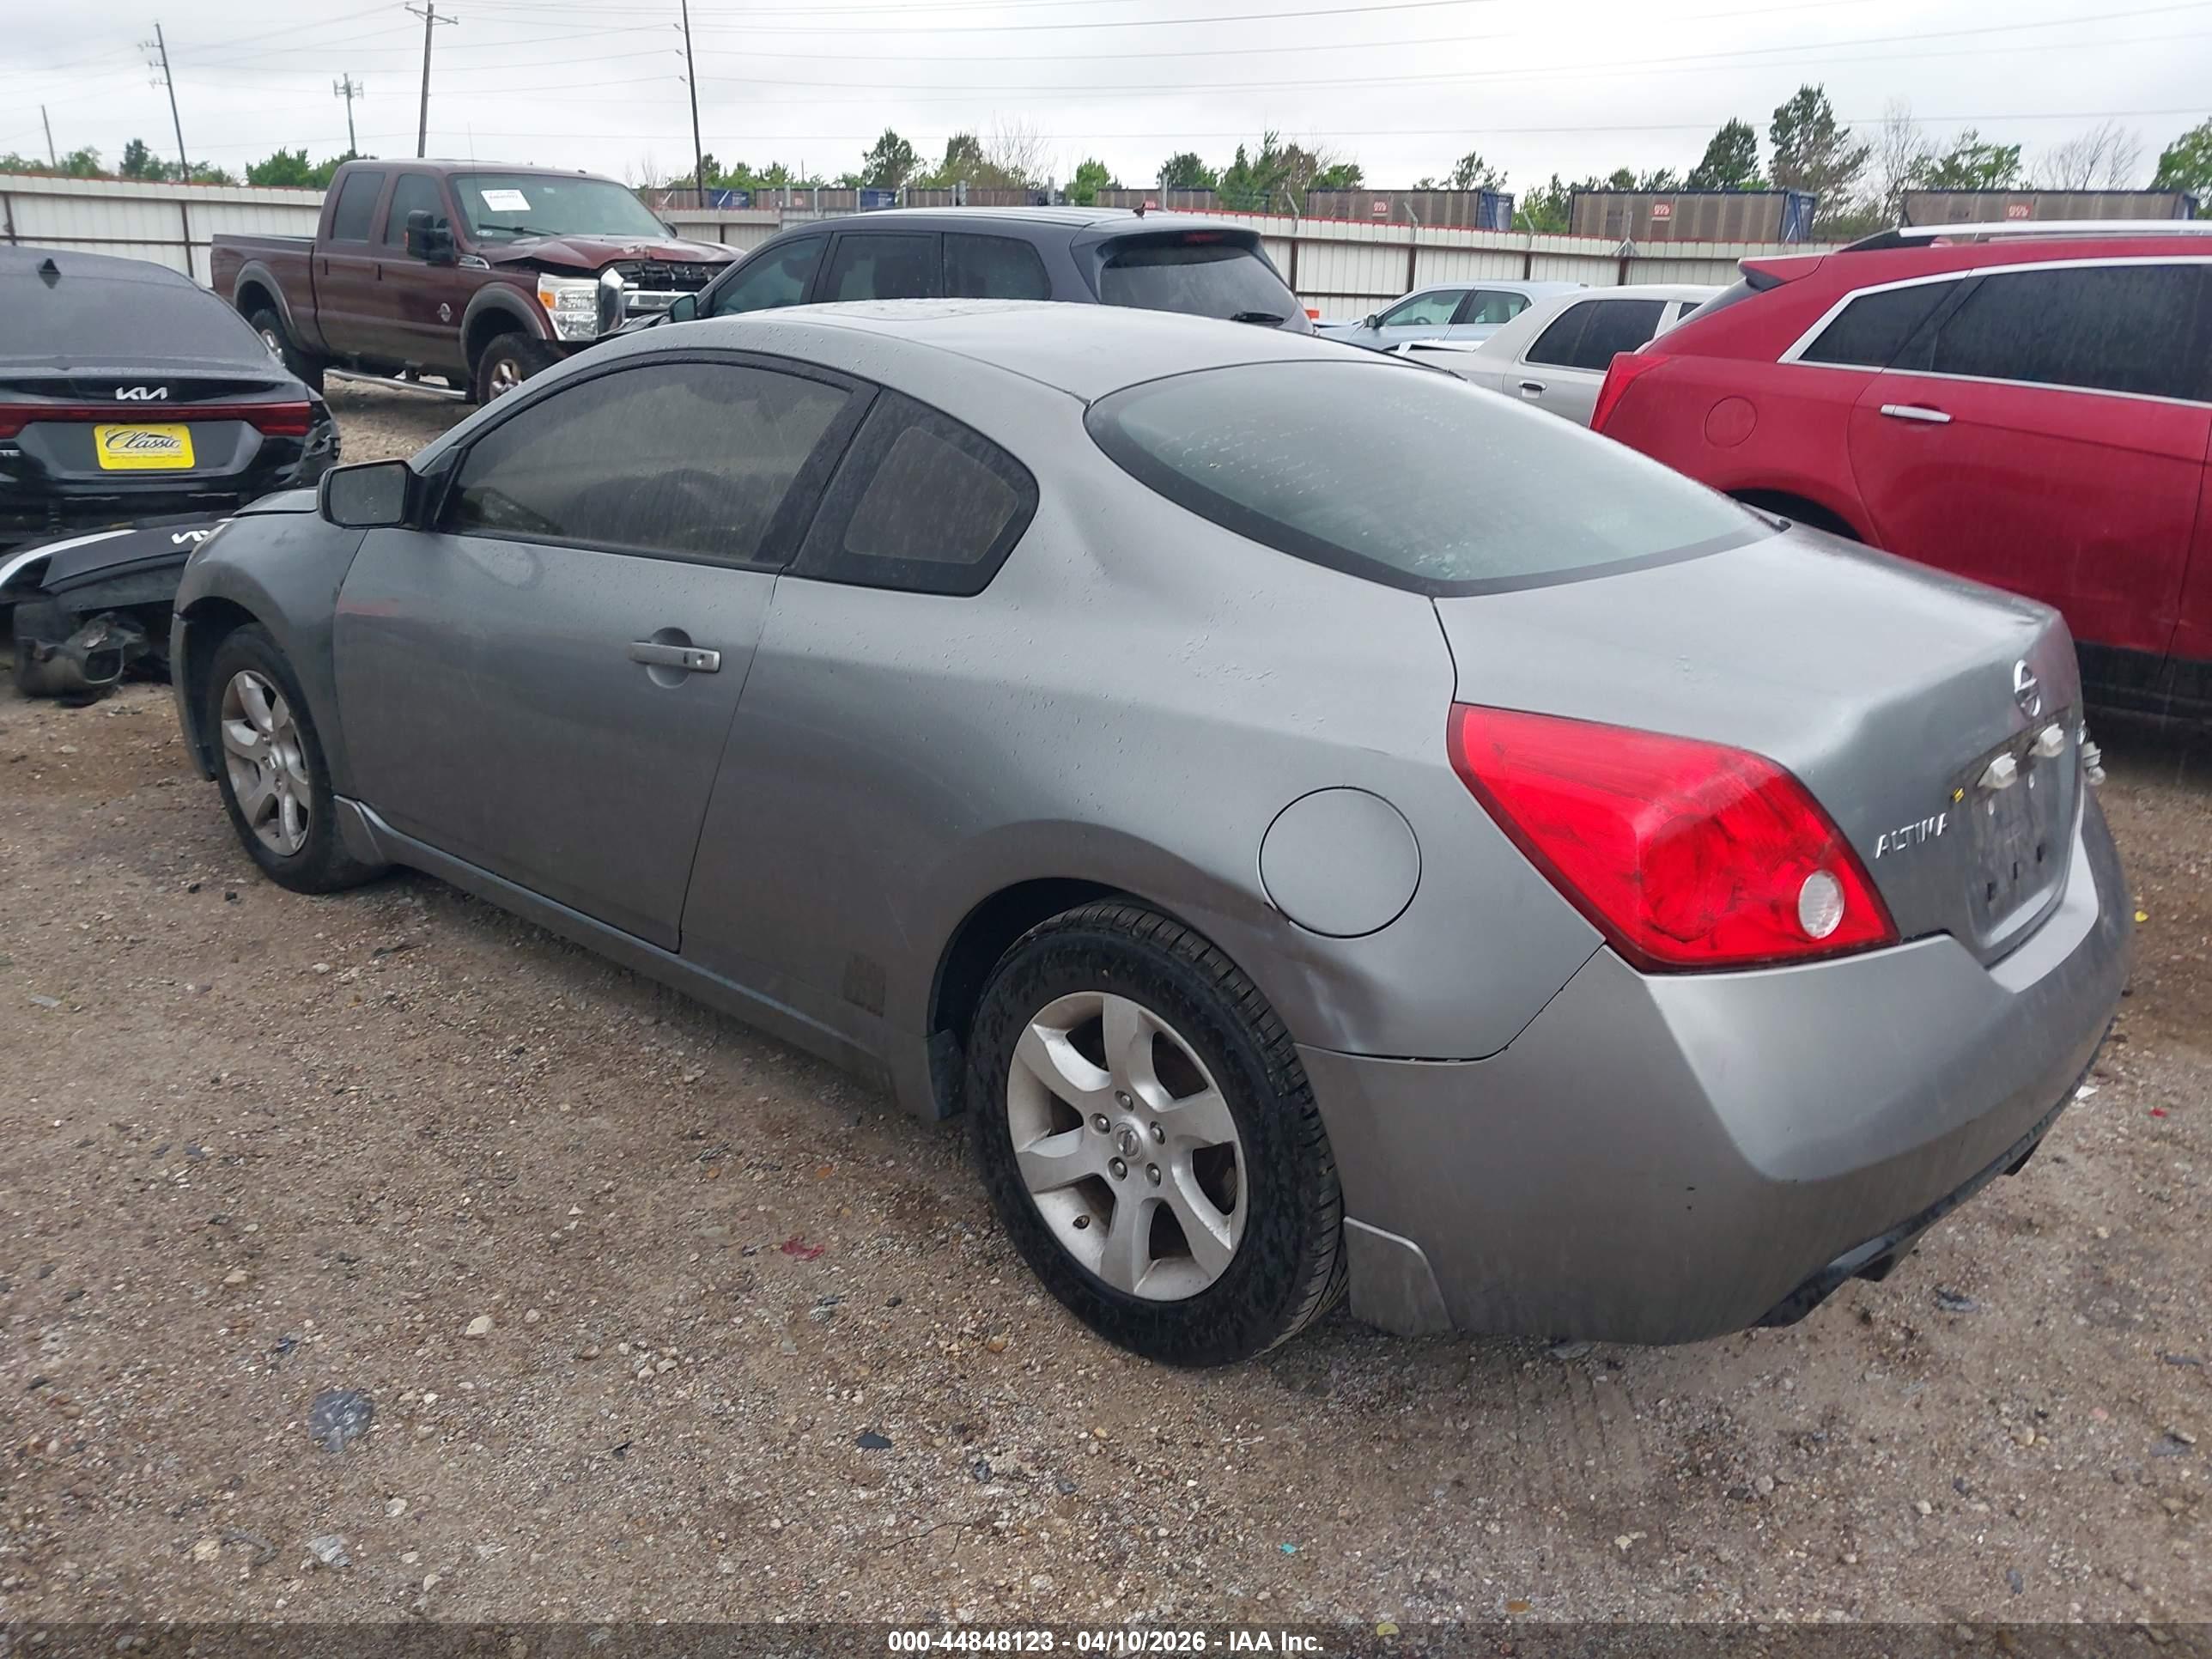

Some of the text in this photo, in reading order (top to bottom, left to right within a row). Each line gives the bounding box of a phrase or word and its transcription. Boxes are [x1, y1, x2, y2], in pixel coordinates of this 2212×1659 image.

[115, 386, 168, 400] KIA
[105, 429, 182, 450] Classic
[1875, 812, 1948, 860] ALTIMA
